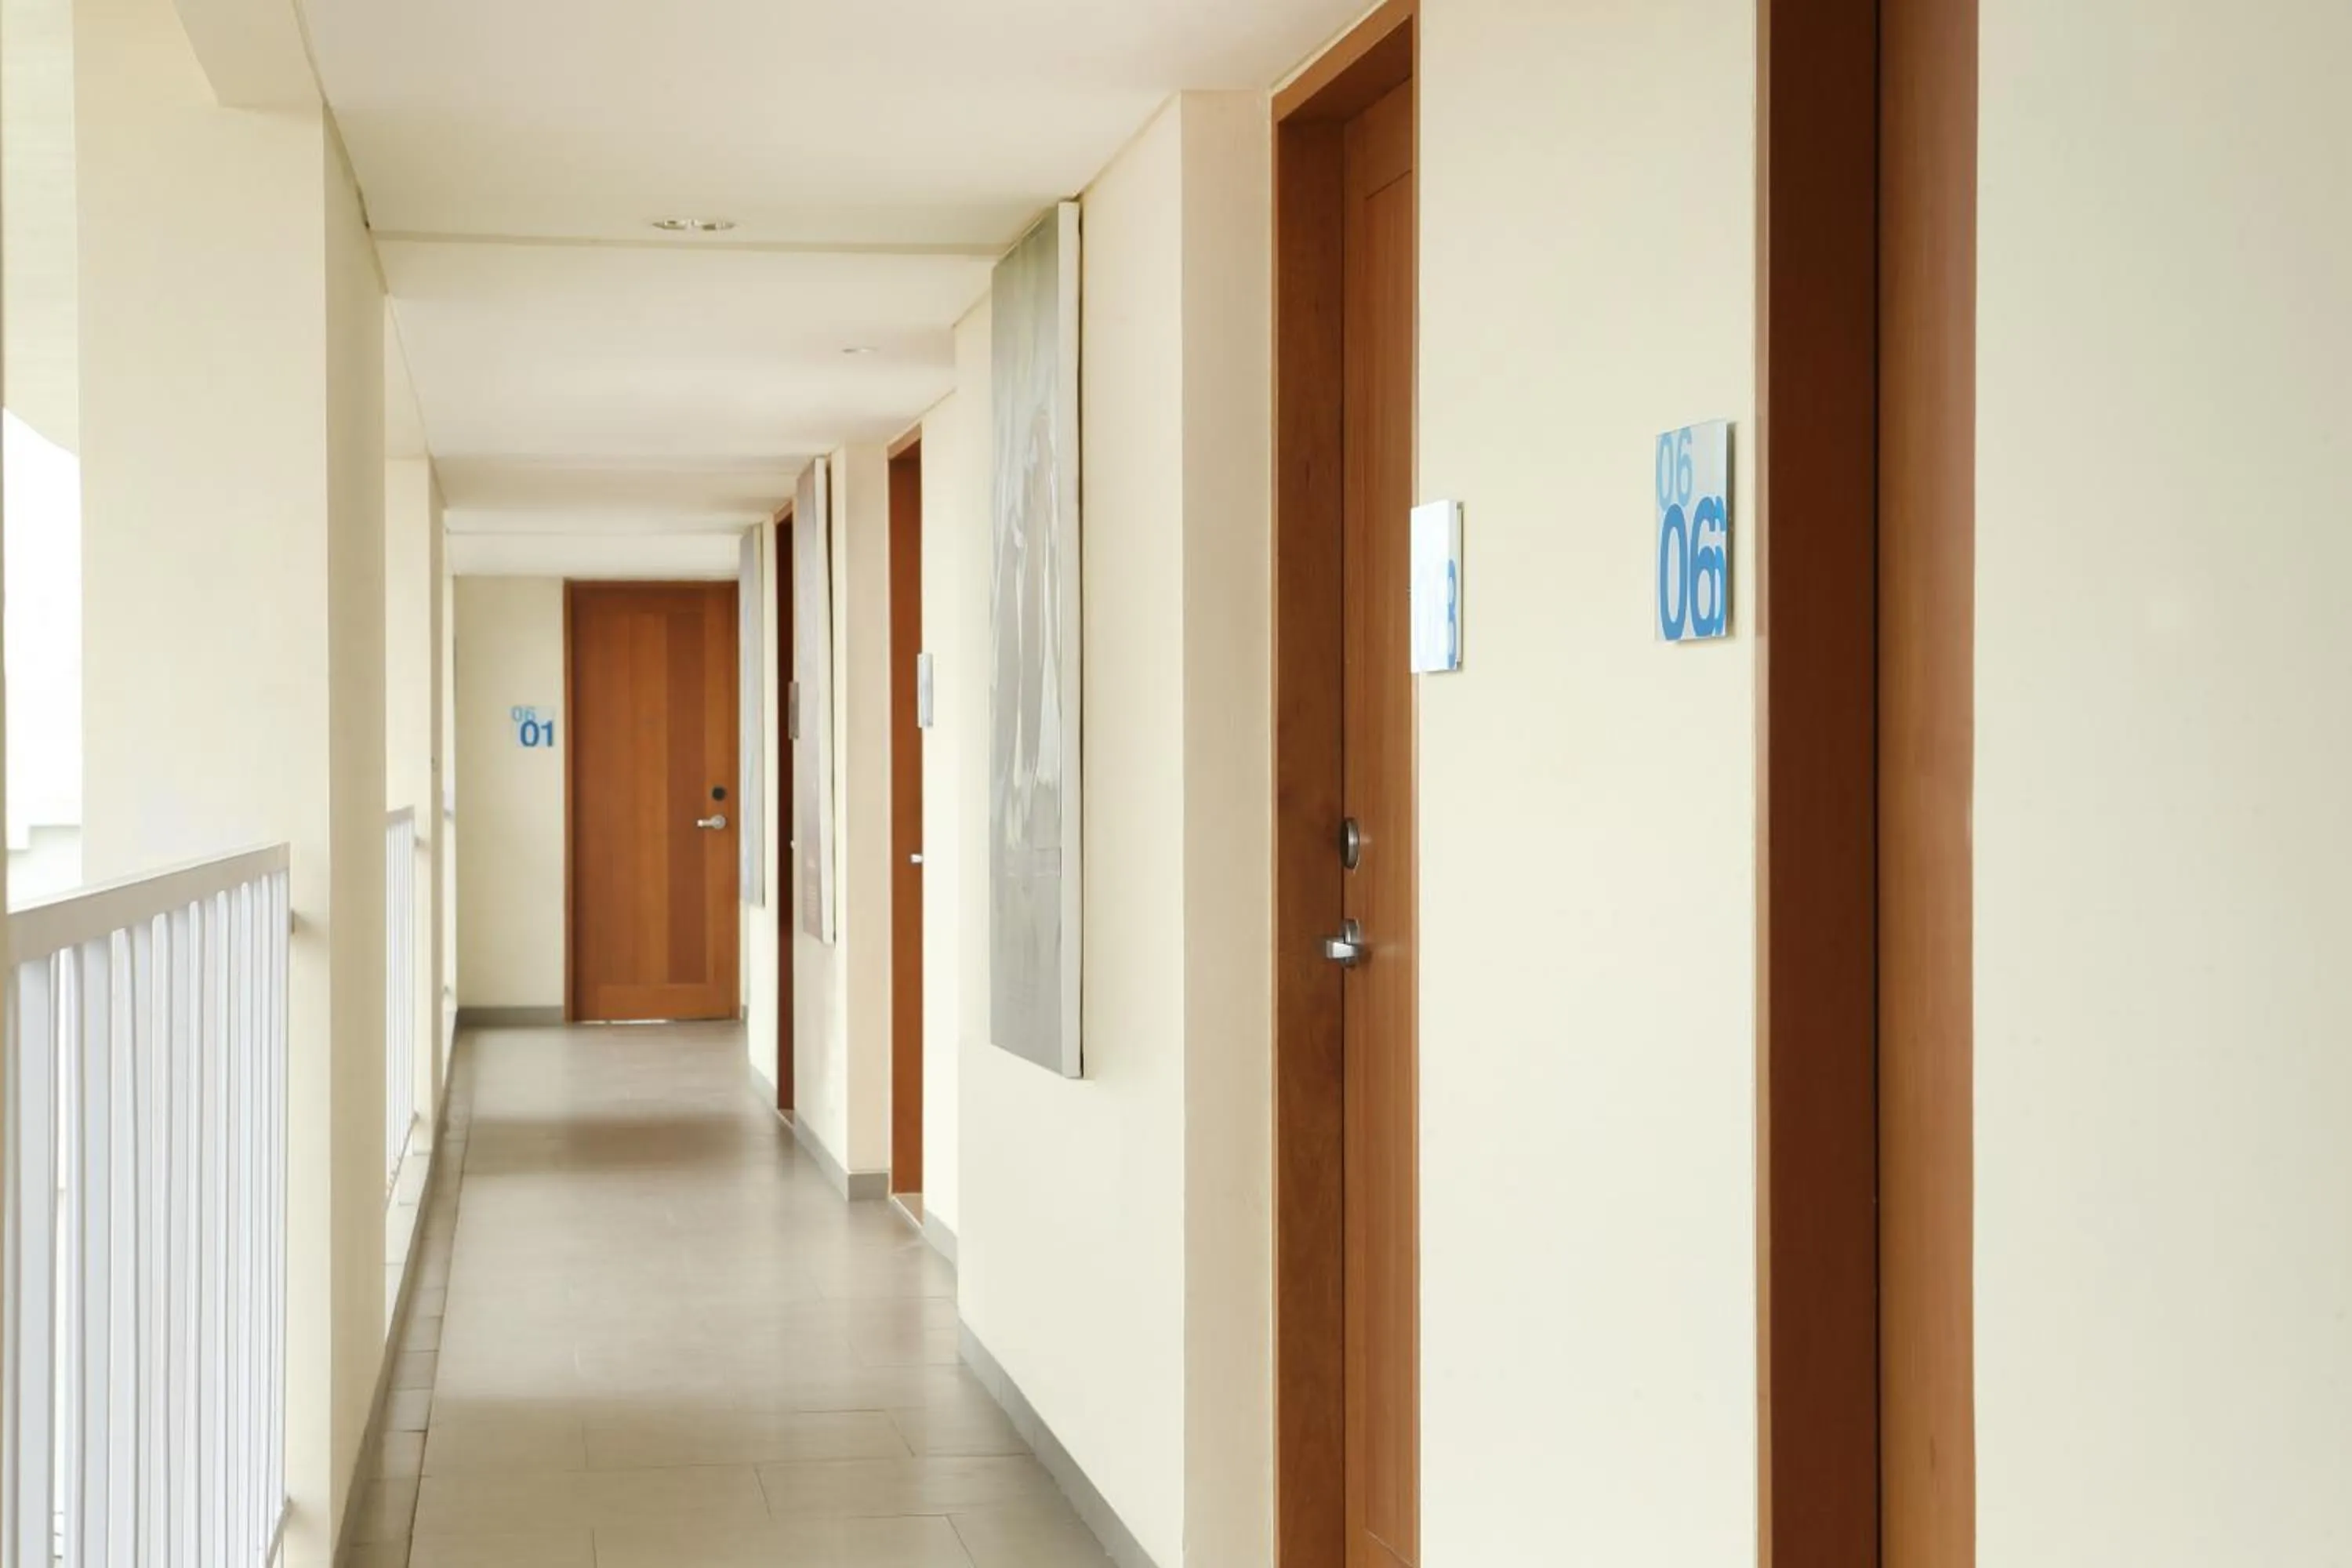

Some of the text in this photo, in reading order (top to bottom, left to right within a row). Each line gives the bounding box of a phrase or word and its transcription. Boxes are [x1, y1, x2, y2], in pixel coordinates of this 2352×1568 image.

[1658, 427, 1693, 510] 06
[1660, 496, 1725, 641] 06
[521, 720, 553, 746] 01
